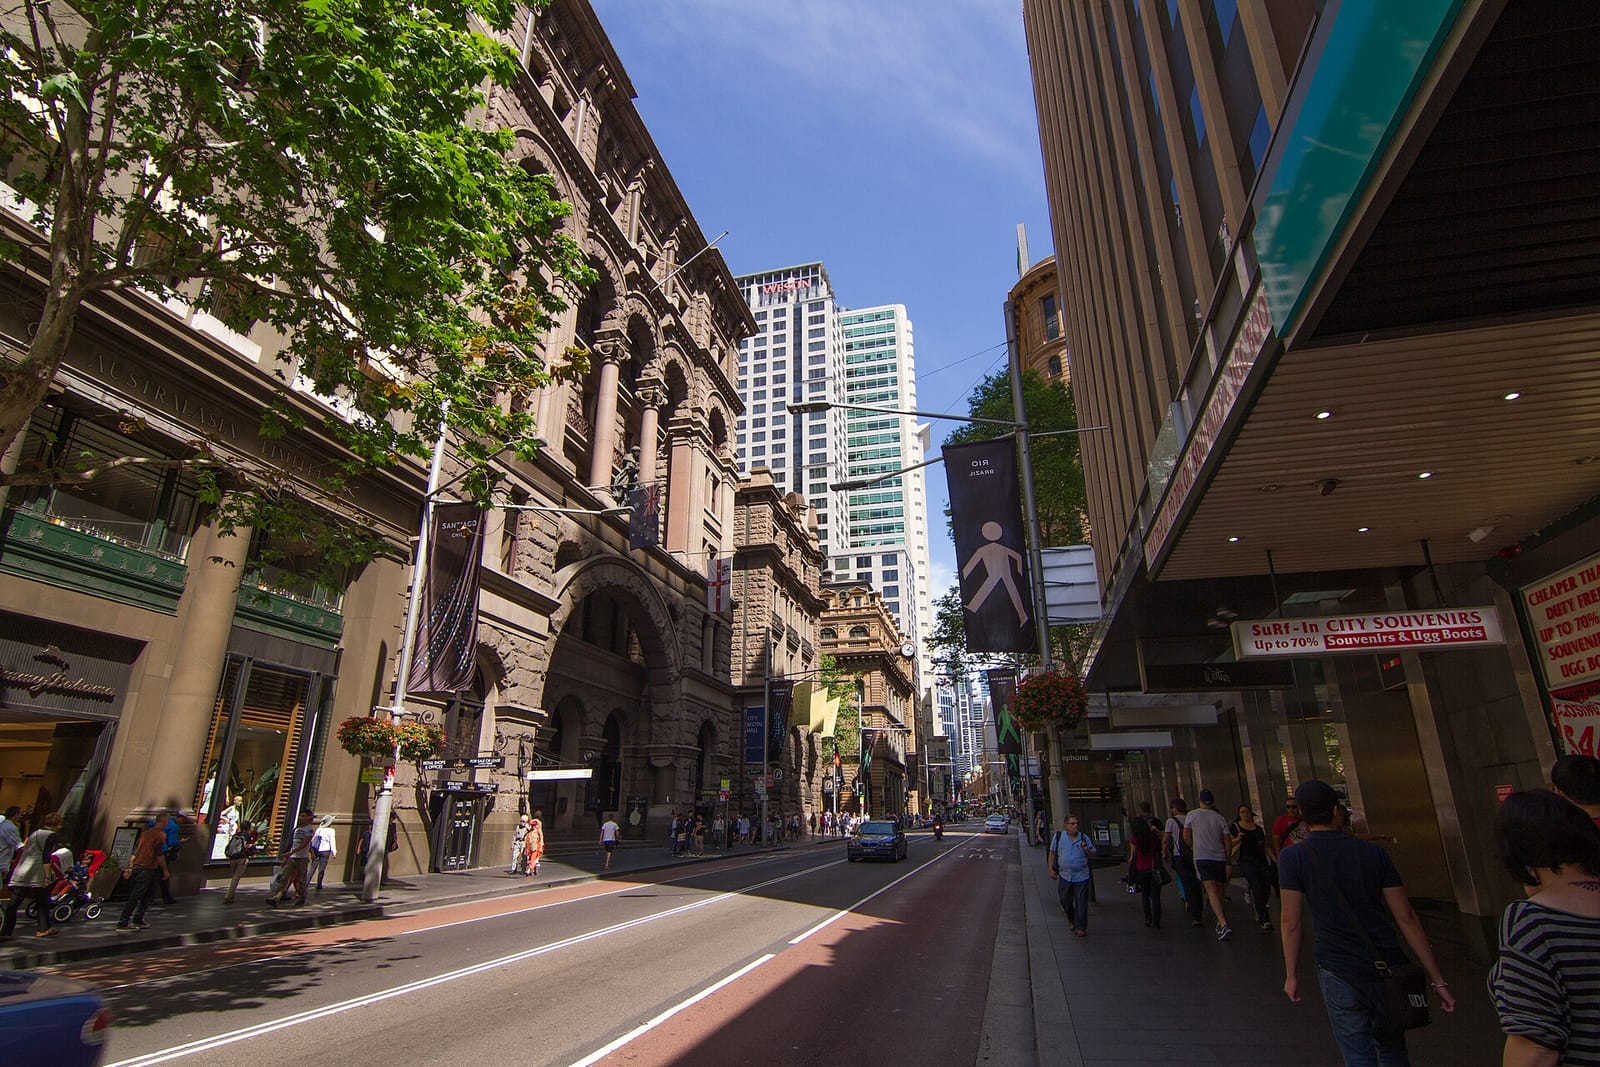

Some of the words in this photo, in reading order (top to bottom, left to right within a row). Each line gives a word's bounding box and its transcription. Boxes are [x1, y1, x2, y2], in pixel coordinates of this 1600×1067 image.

[763, 279, 812, 294] WESTIN
[1528, 576, 1577, 606] CHEAPER
[1545, 598, 1574, 620] DUTY
[1326, 618, 1365, 632] CITY
[1373, 611, 1481, 629] SOUVENIRS
[1540, 627, 1554, 642] UP
[1556, 621, 1571, 637] TO
[1574, 612, 1599, 631] 70%
[1255, 640, 1273, 651] Up
[1275, 639, 1289, 648] to
[1290, 637, 1319, 647] 70%
[1327, 633, 1396, 646] Souvenirs
[1398, 632, 1410, 641] &
[1412, 629, 1440, 643] Ugg
[1442, 628, 1483, 640] Boots
[1560, 660, 1585, 677] UGG
[1062, 752, 1089, 763] ephone
